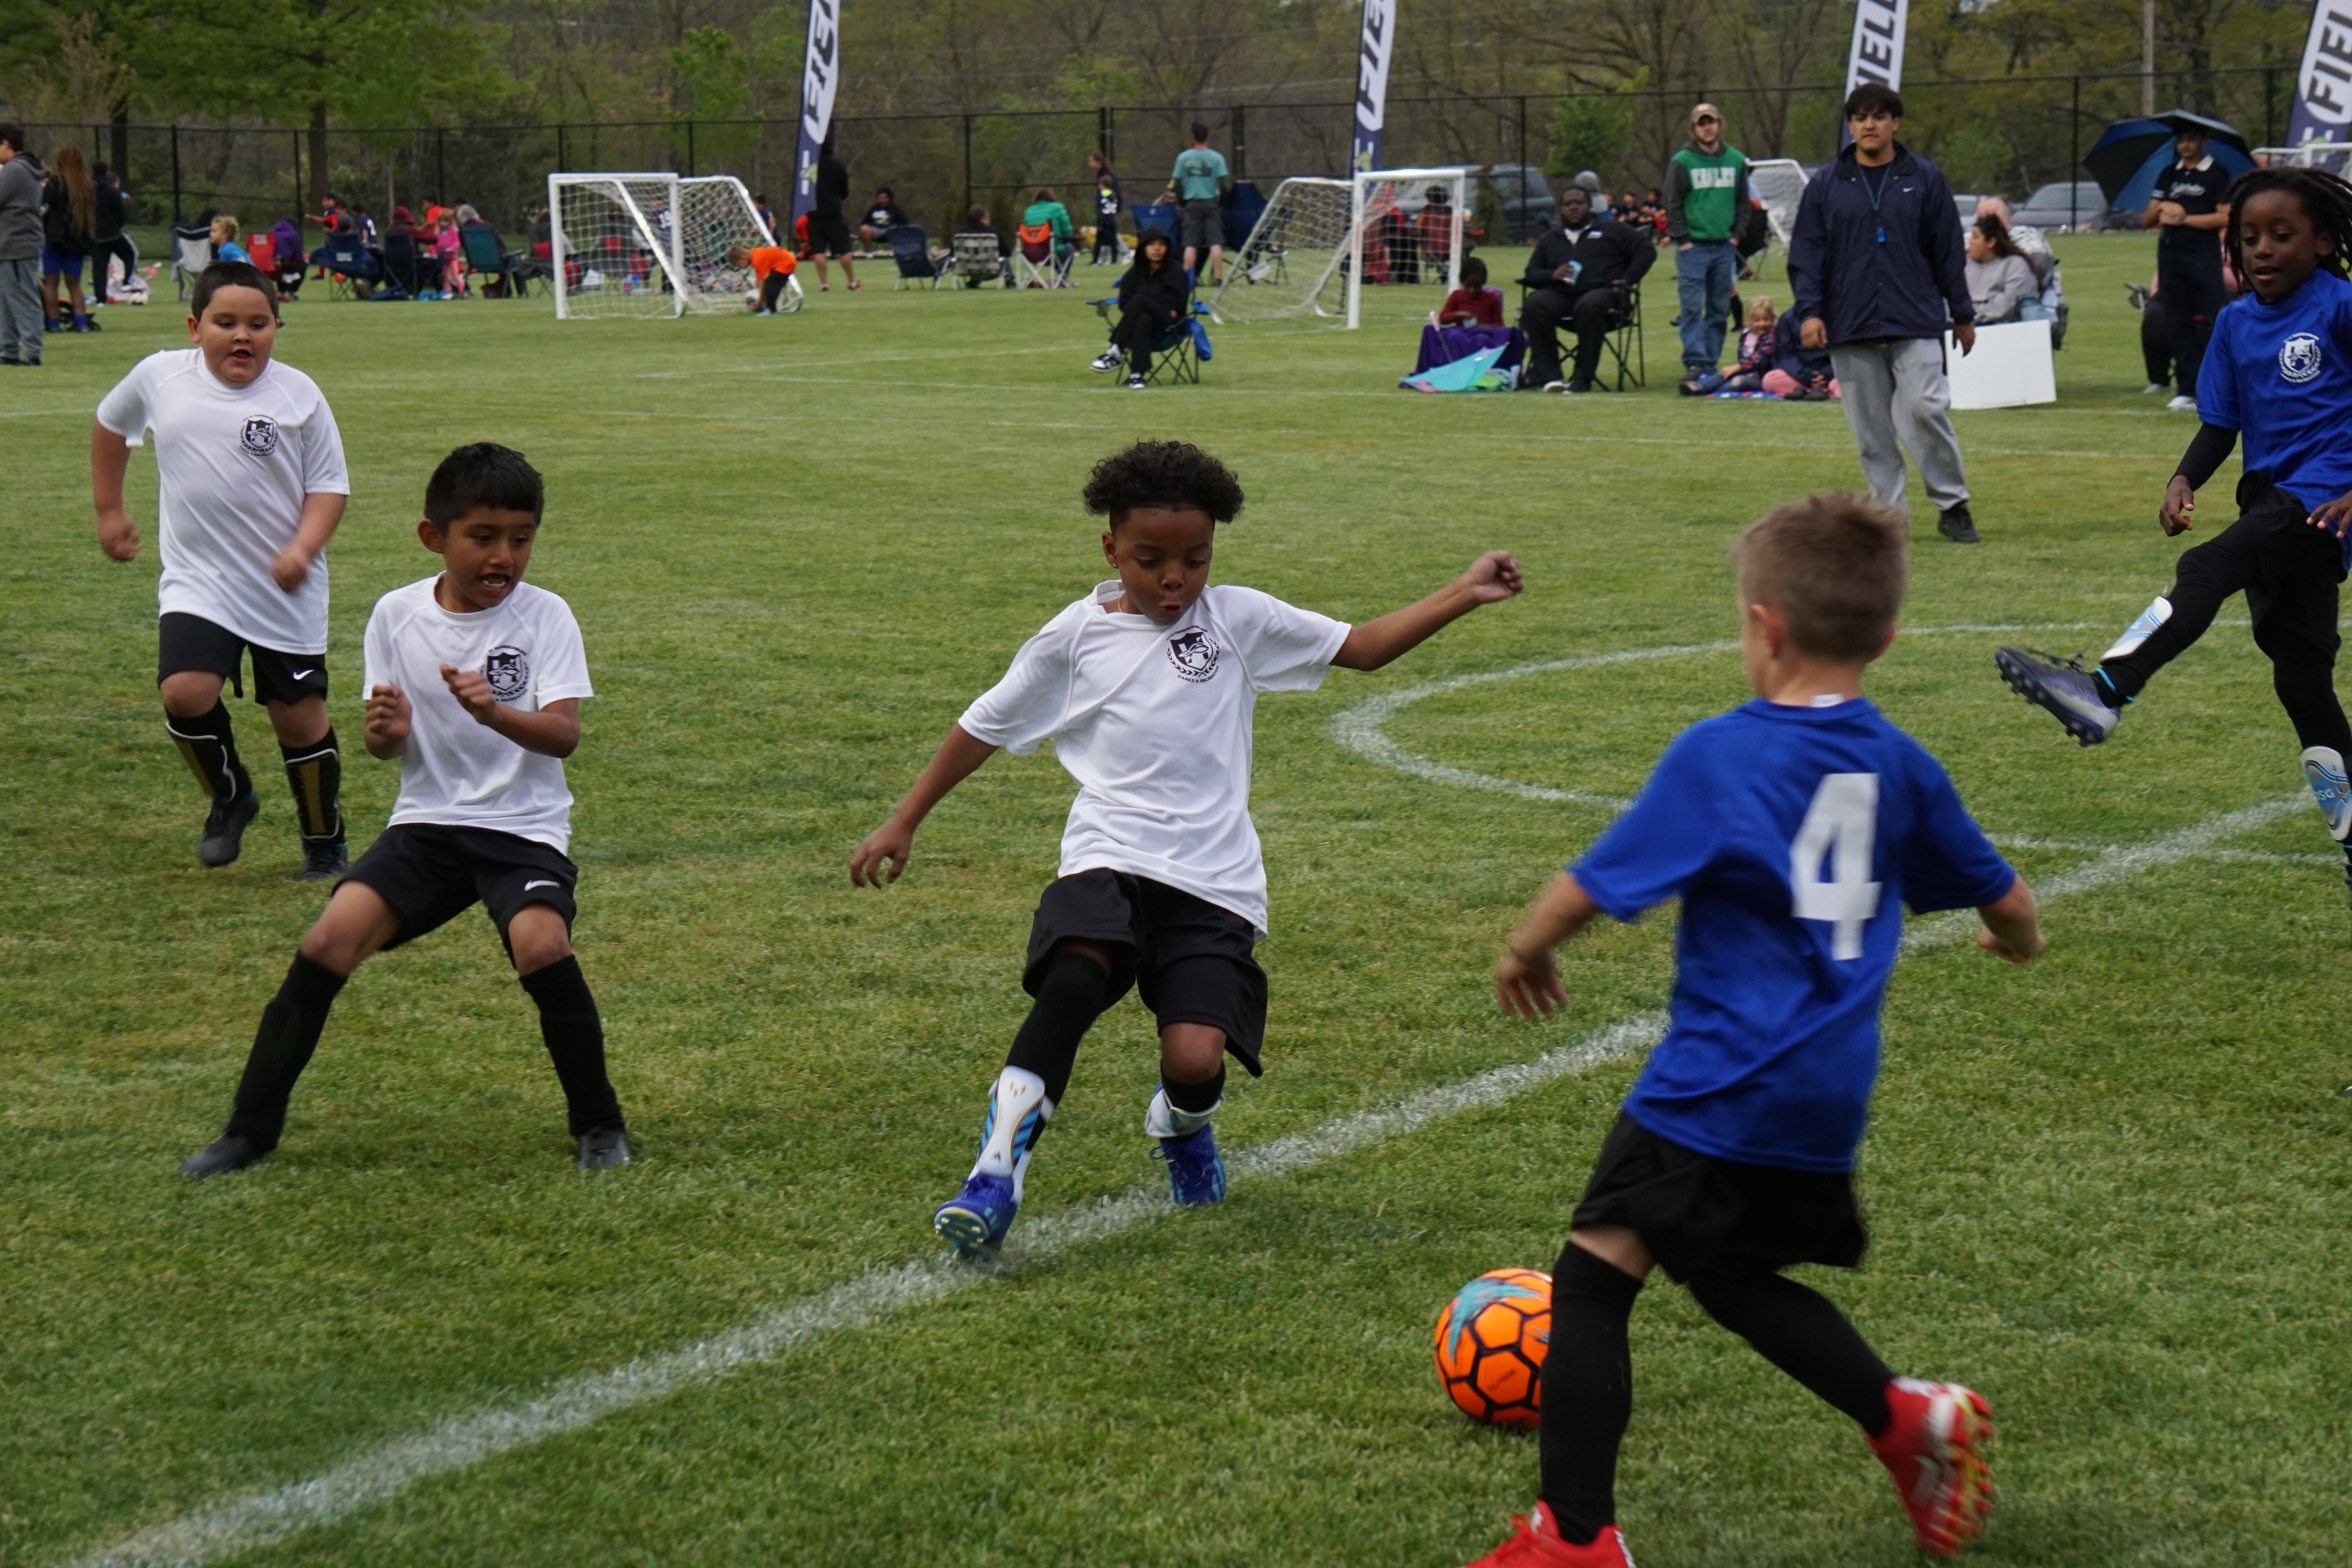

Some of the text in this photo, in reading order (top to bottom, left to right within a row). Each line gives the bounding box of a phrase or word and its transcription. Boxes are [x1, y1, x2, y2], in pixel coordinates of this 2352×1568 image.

[1200, 665, 1219, 683] RECREATION
[2316, 788, 2336, 801] SG
[1789, 773, 1883, 960] 4
